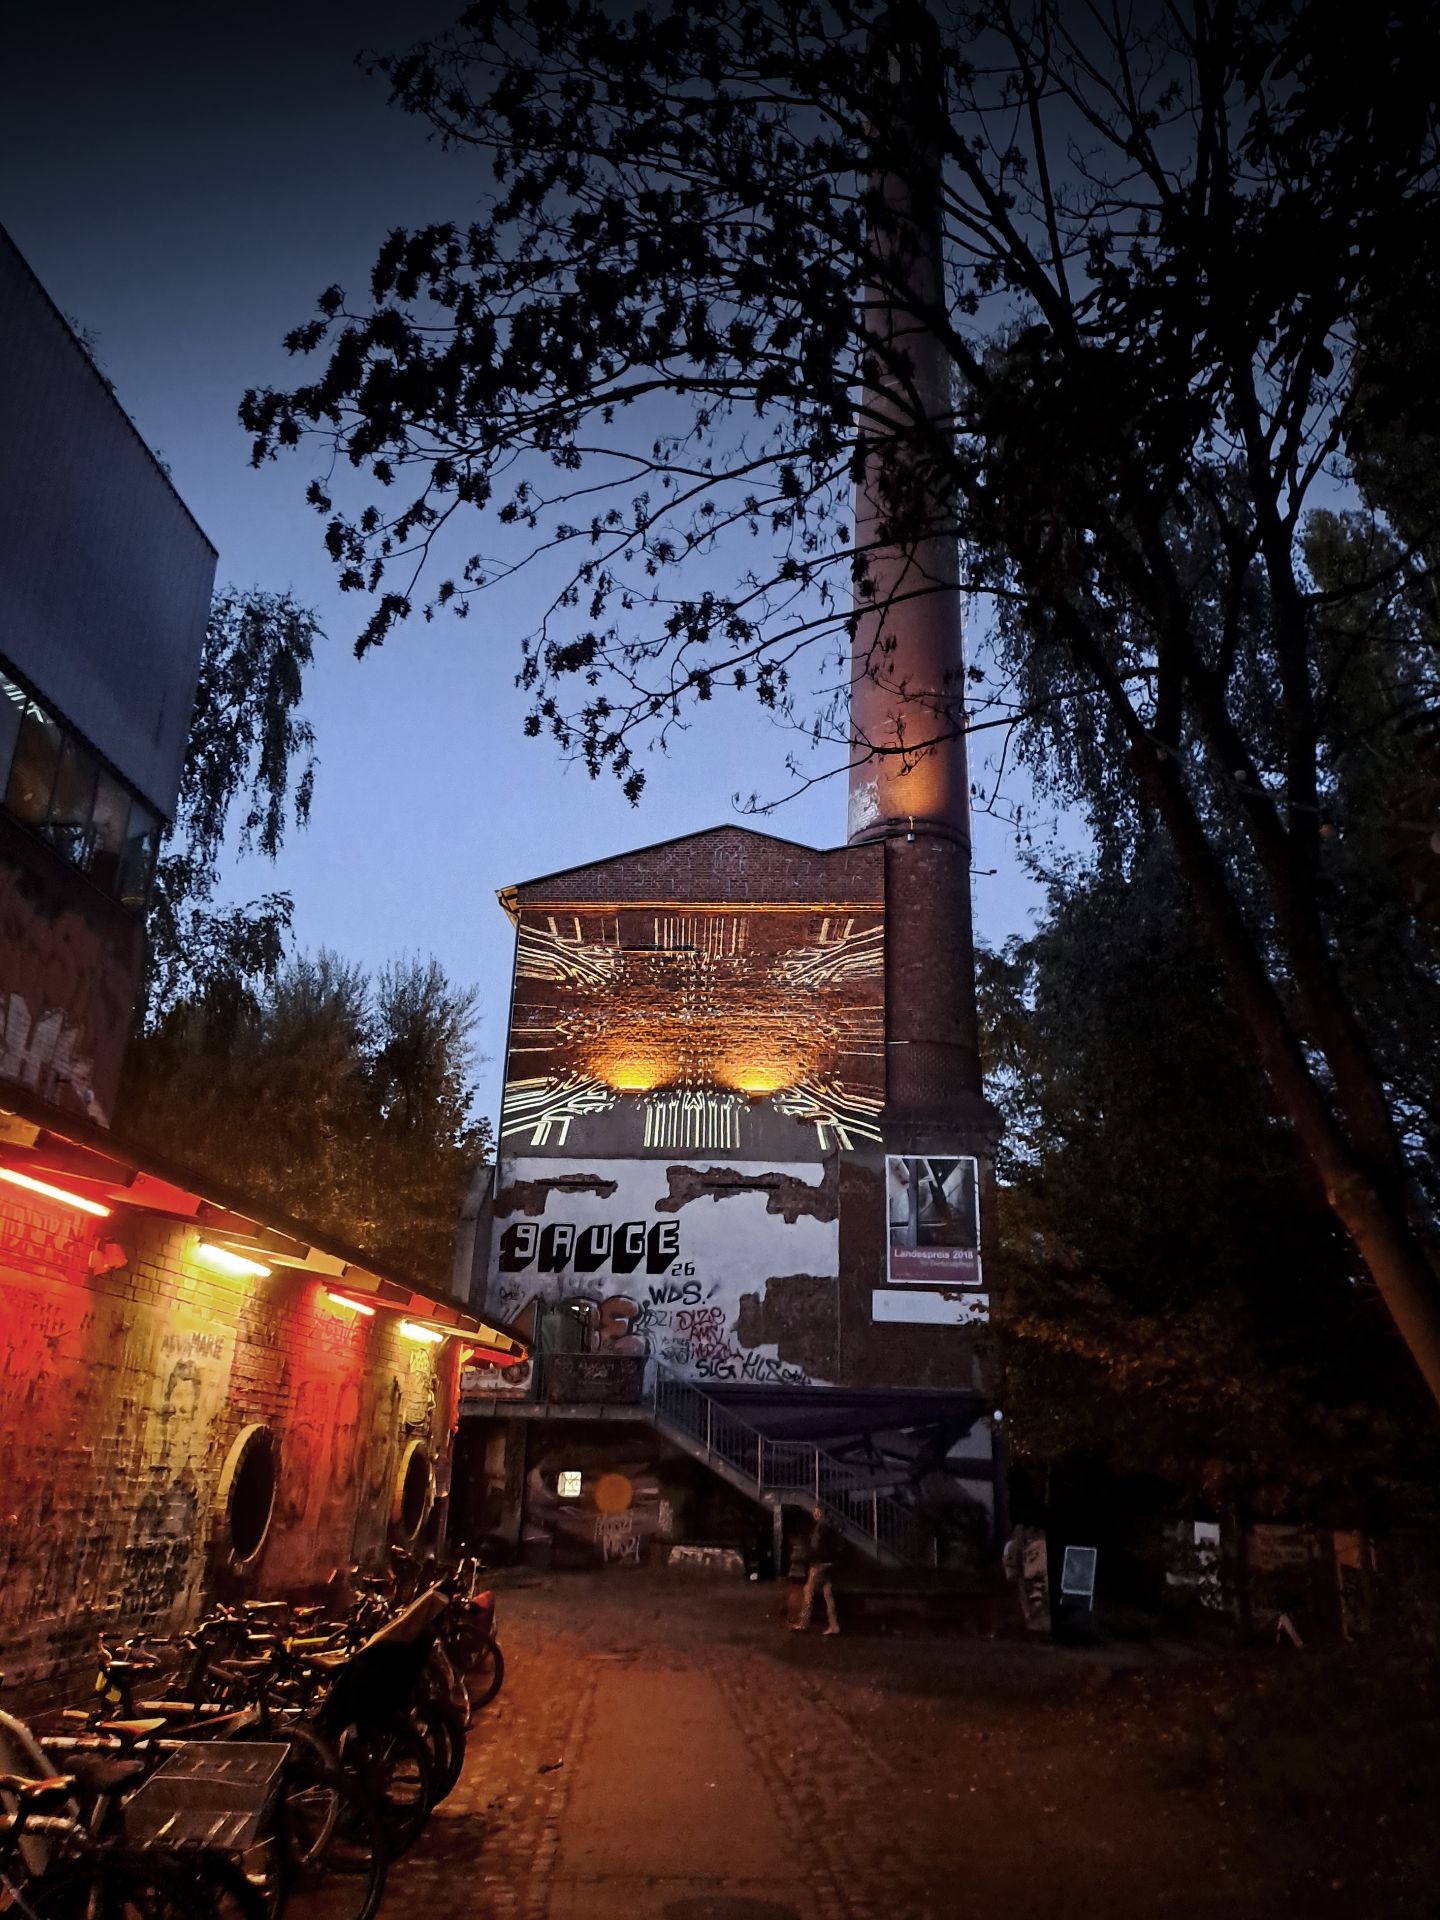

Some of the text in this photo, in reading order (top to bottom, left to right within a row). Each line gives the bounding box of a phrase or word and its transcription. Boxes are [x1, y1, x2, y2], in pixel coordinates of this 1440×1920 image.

[894, 1249, 974, 1260] Landespreis 2018
[671, 1262, 696, 1277] 26
